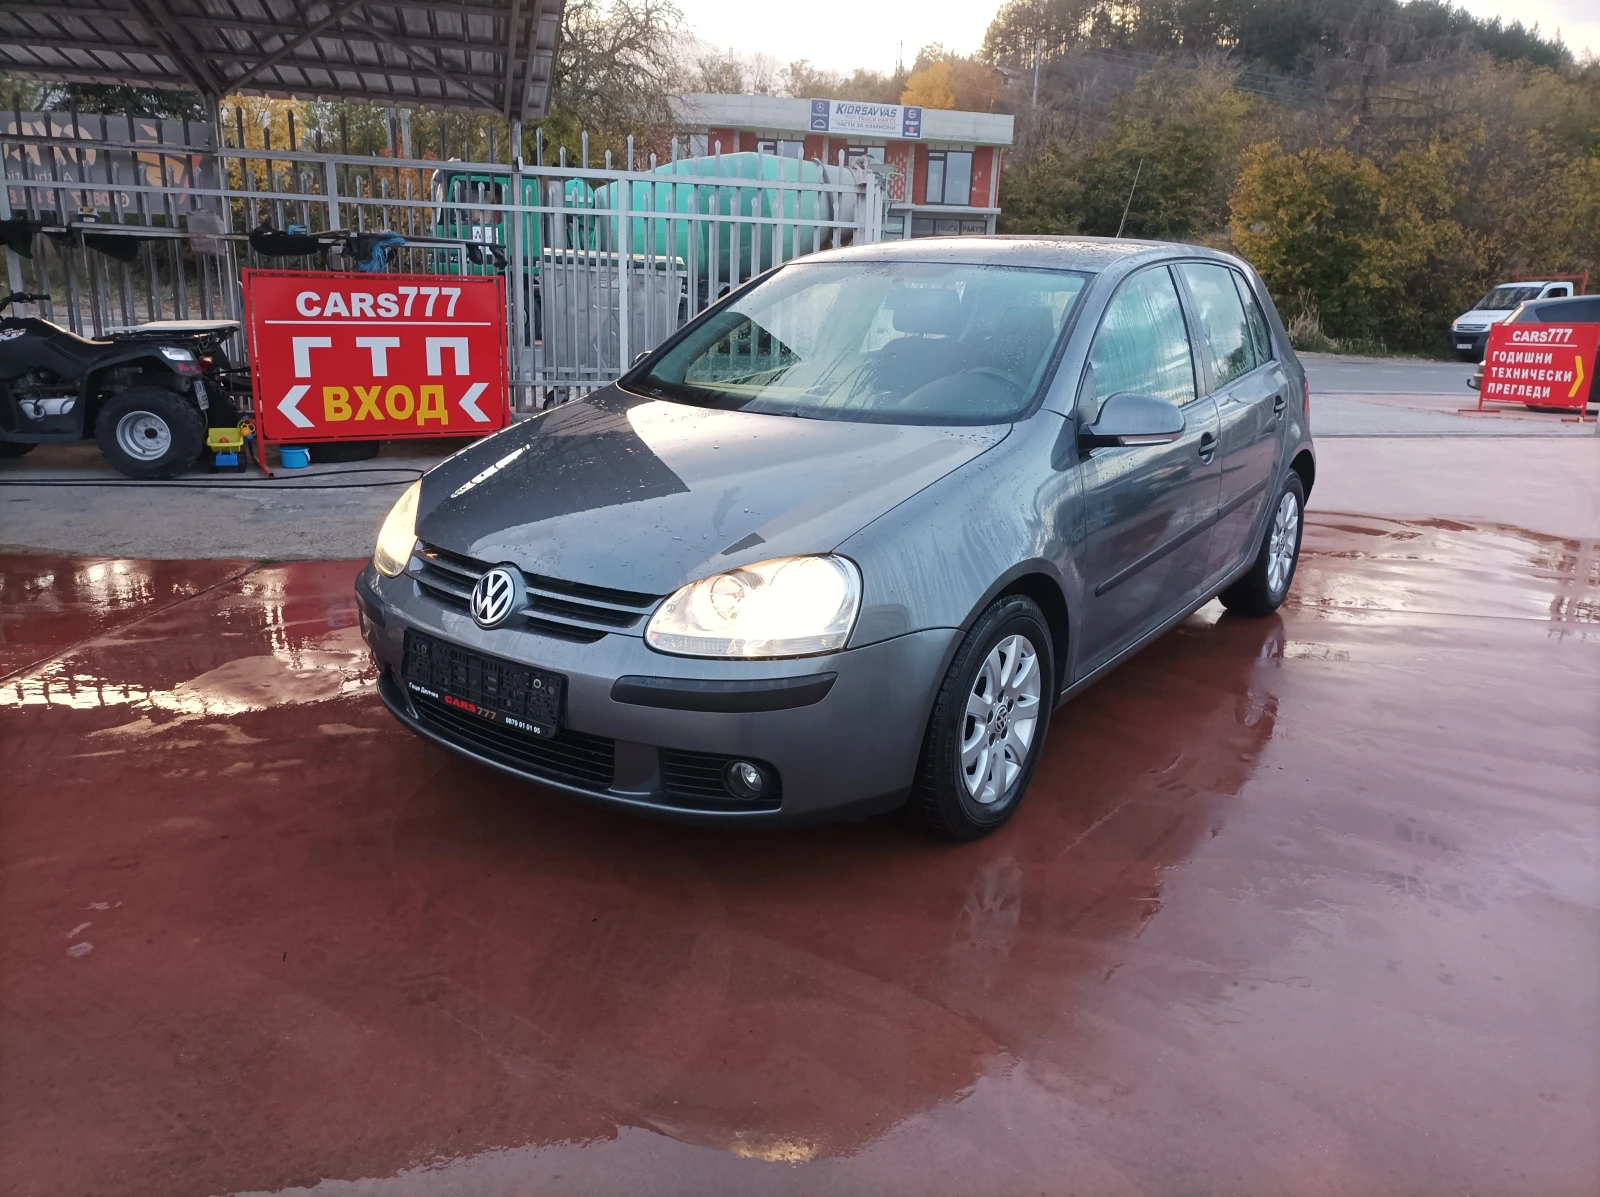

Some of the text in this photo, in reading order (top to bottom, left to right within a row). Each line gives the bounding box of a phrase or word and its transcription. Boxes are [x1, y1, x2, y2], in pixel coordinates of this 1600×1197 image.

[865, 123, 896, 131] КАМИОНИ
[295, 286, 461, 317] CARS777
[1512, 328, 1573, 343] CARS777
[1492, 350, 1553, 364] ГОДИШНИ
[1491, 366, 1573, 382] ТЕХНИЧЕСКИ
[1487, 382, 1551, 399] ПРЕГЛЕДИ
[322, 384, 449, 426] ВХОД
[518, 721, 525, 730] 01
[533, 726, 541, 735] 05
